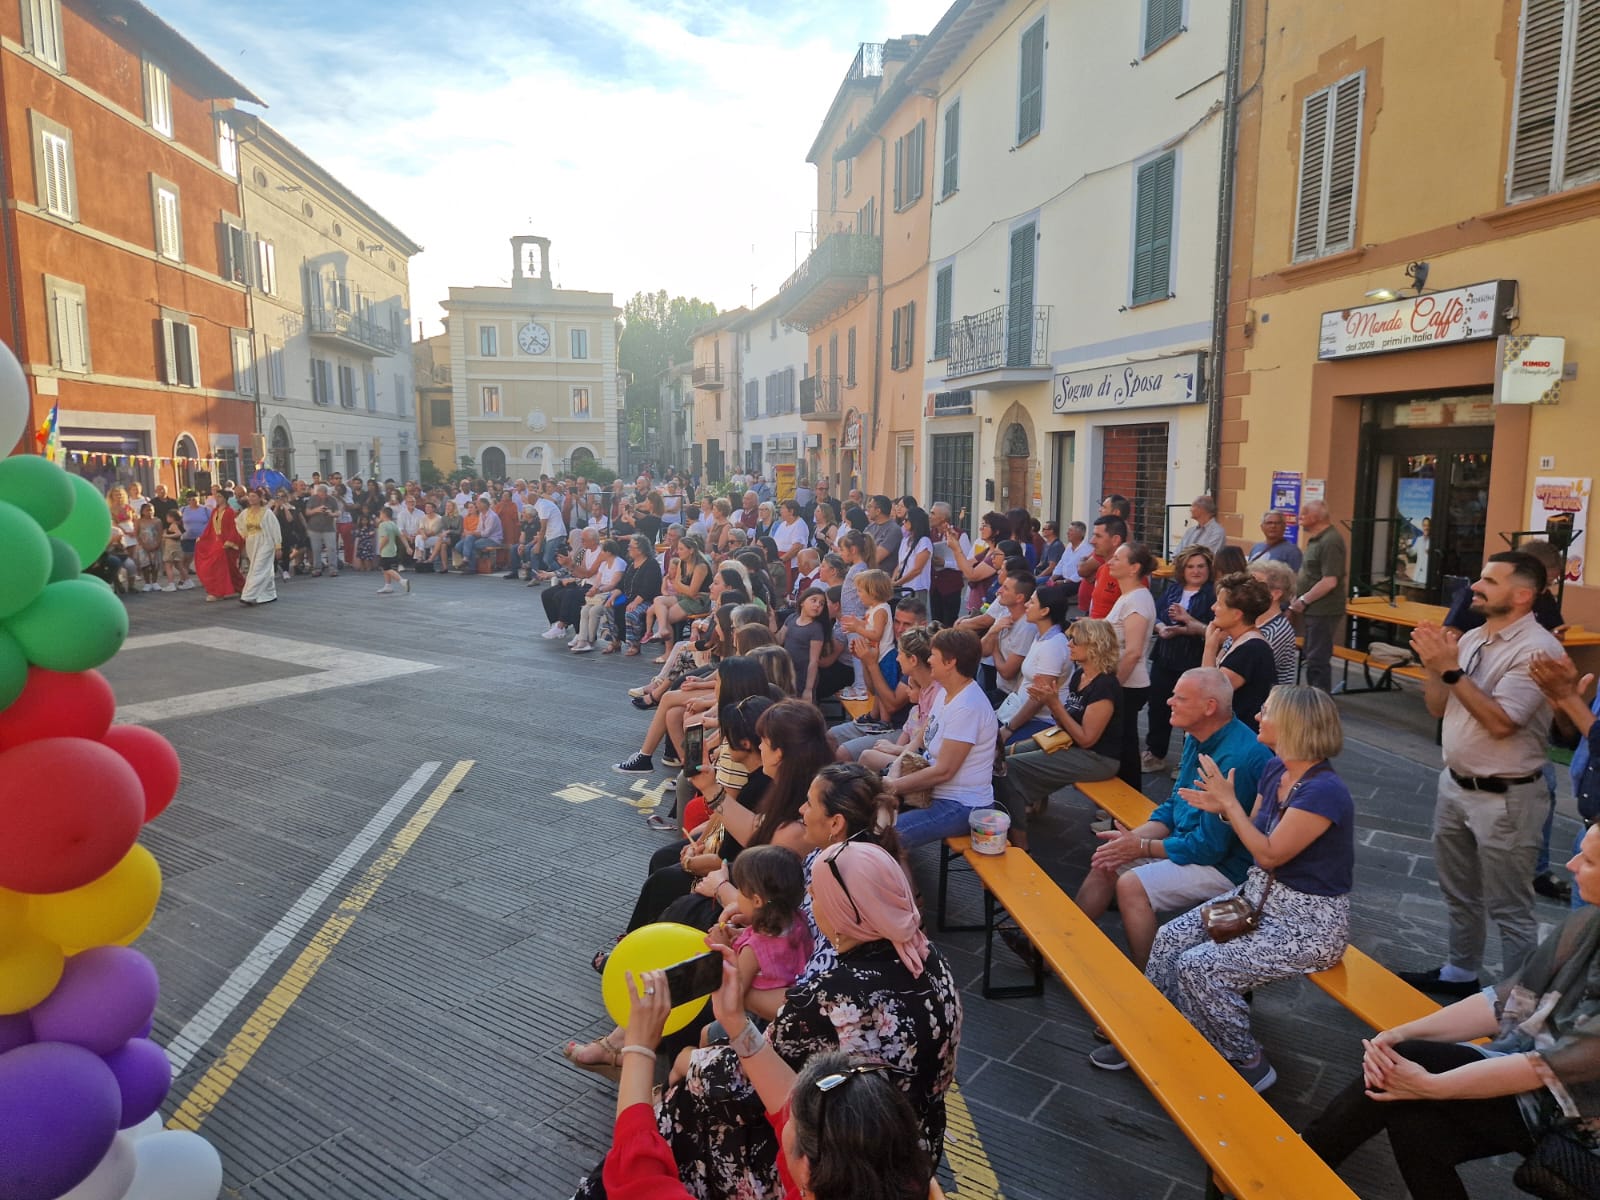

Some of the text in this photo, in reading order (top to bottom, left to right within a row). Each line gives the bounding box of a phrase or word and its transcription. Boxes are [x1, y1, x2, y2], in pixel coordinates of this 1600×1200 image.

[1347, 297, 1464, 339] Mondo Caffè
[1346, 344, 1356, 352] dal
[1382, 335, 1403, 349] primi
[1403, 336, 1411, 344] in
[1054, 367, 1163, 409] Sogno di Sposa
